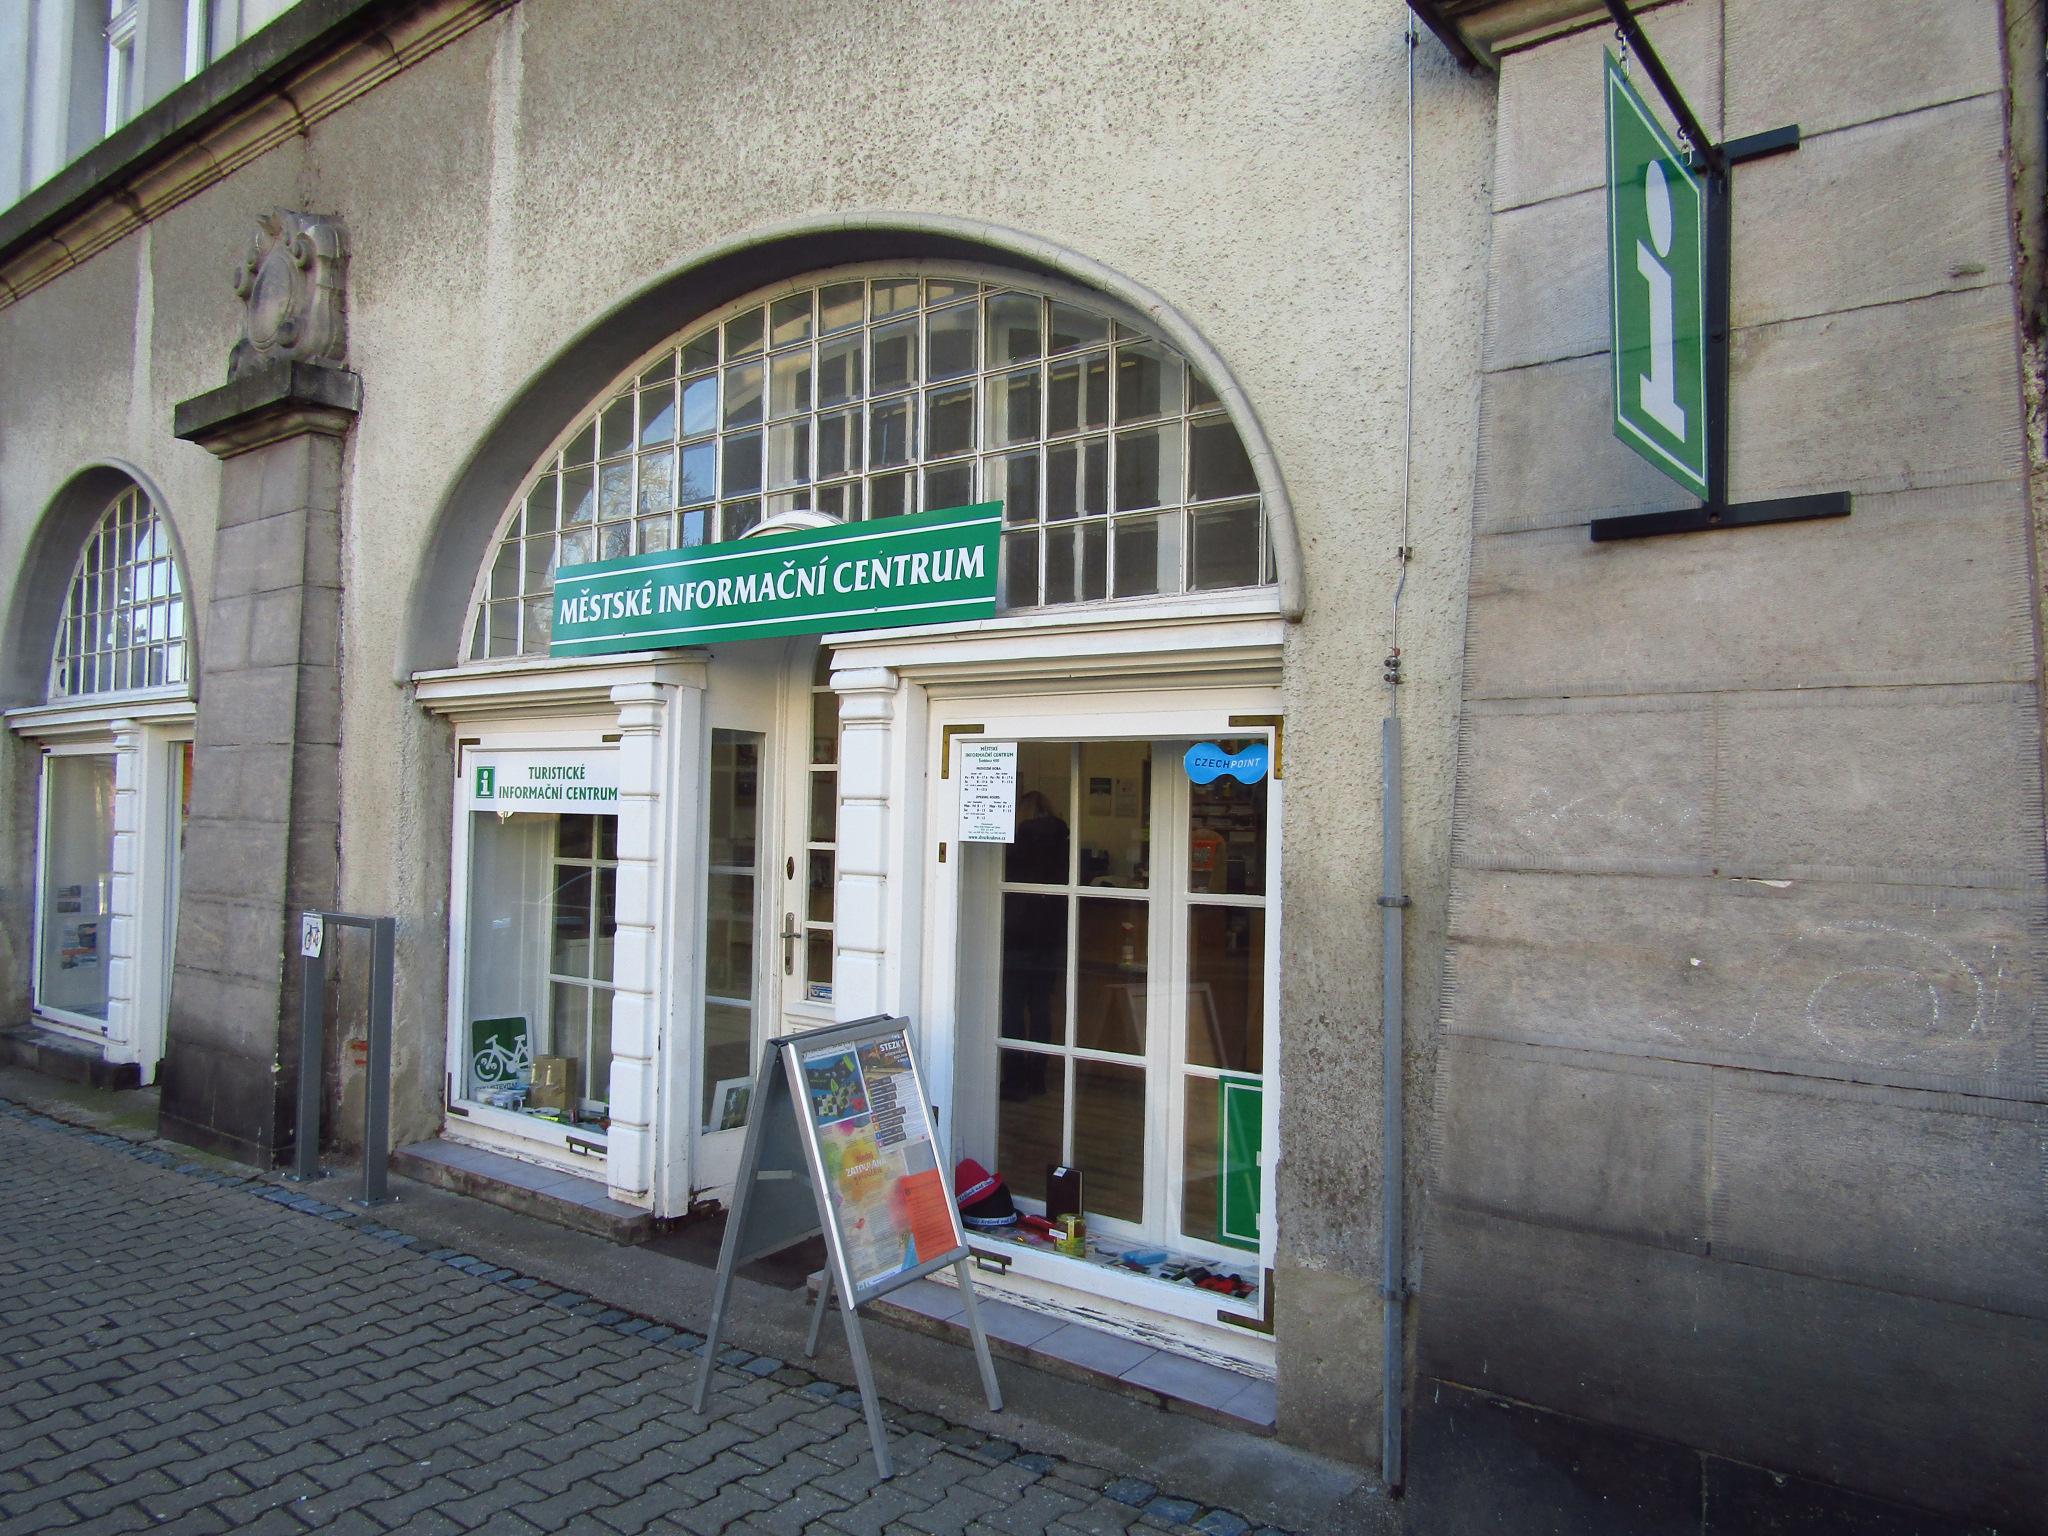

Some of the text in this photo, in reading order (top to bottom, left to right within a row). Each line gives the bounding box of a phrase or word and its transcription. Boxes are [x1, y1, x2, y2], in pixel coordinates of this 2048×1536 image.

[559, 544, 985, 625] MĚSTSKÉ INFORMAČNÍ CENTRUM
[528, 763, 586, 780] TURISTICKÉ
[499, 784, 618, 801] INFORMAČNÍ CENTRUM
[879, 1040, 905, 1052] STEZKY
